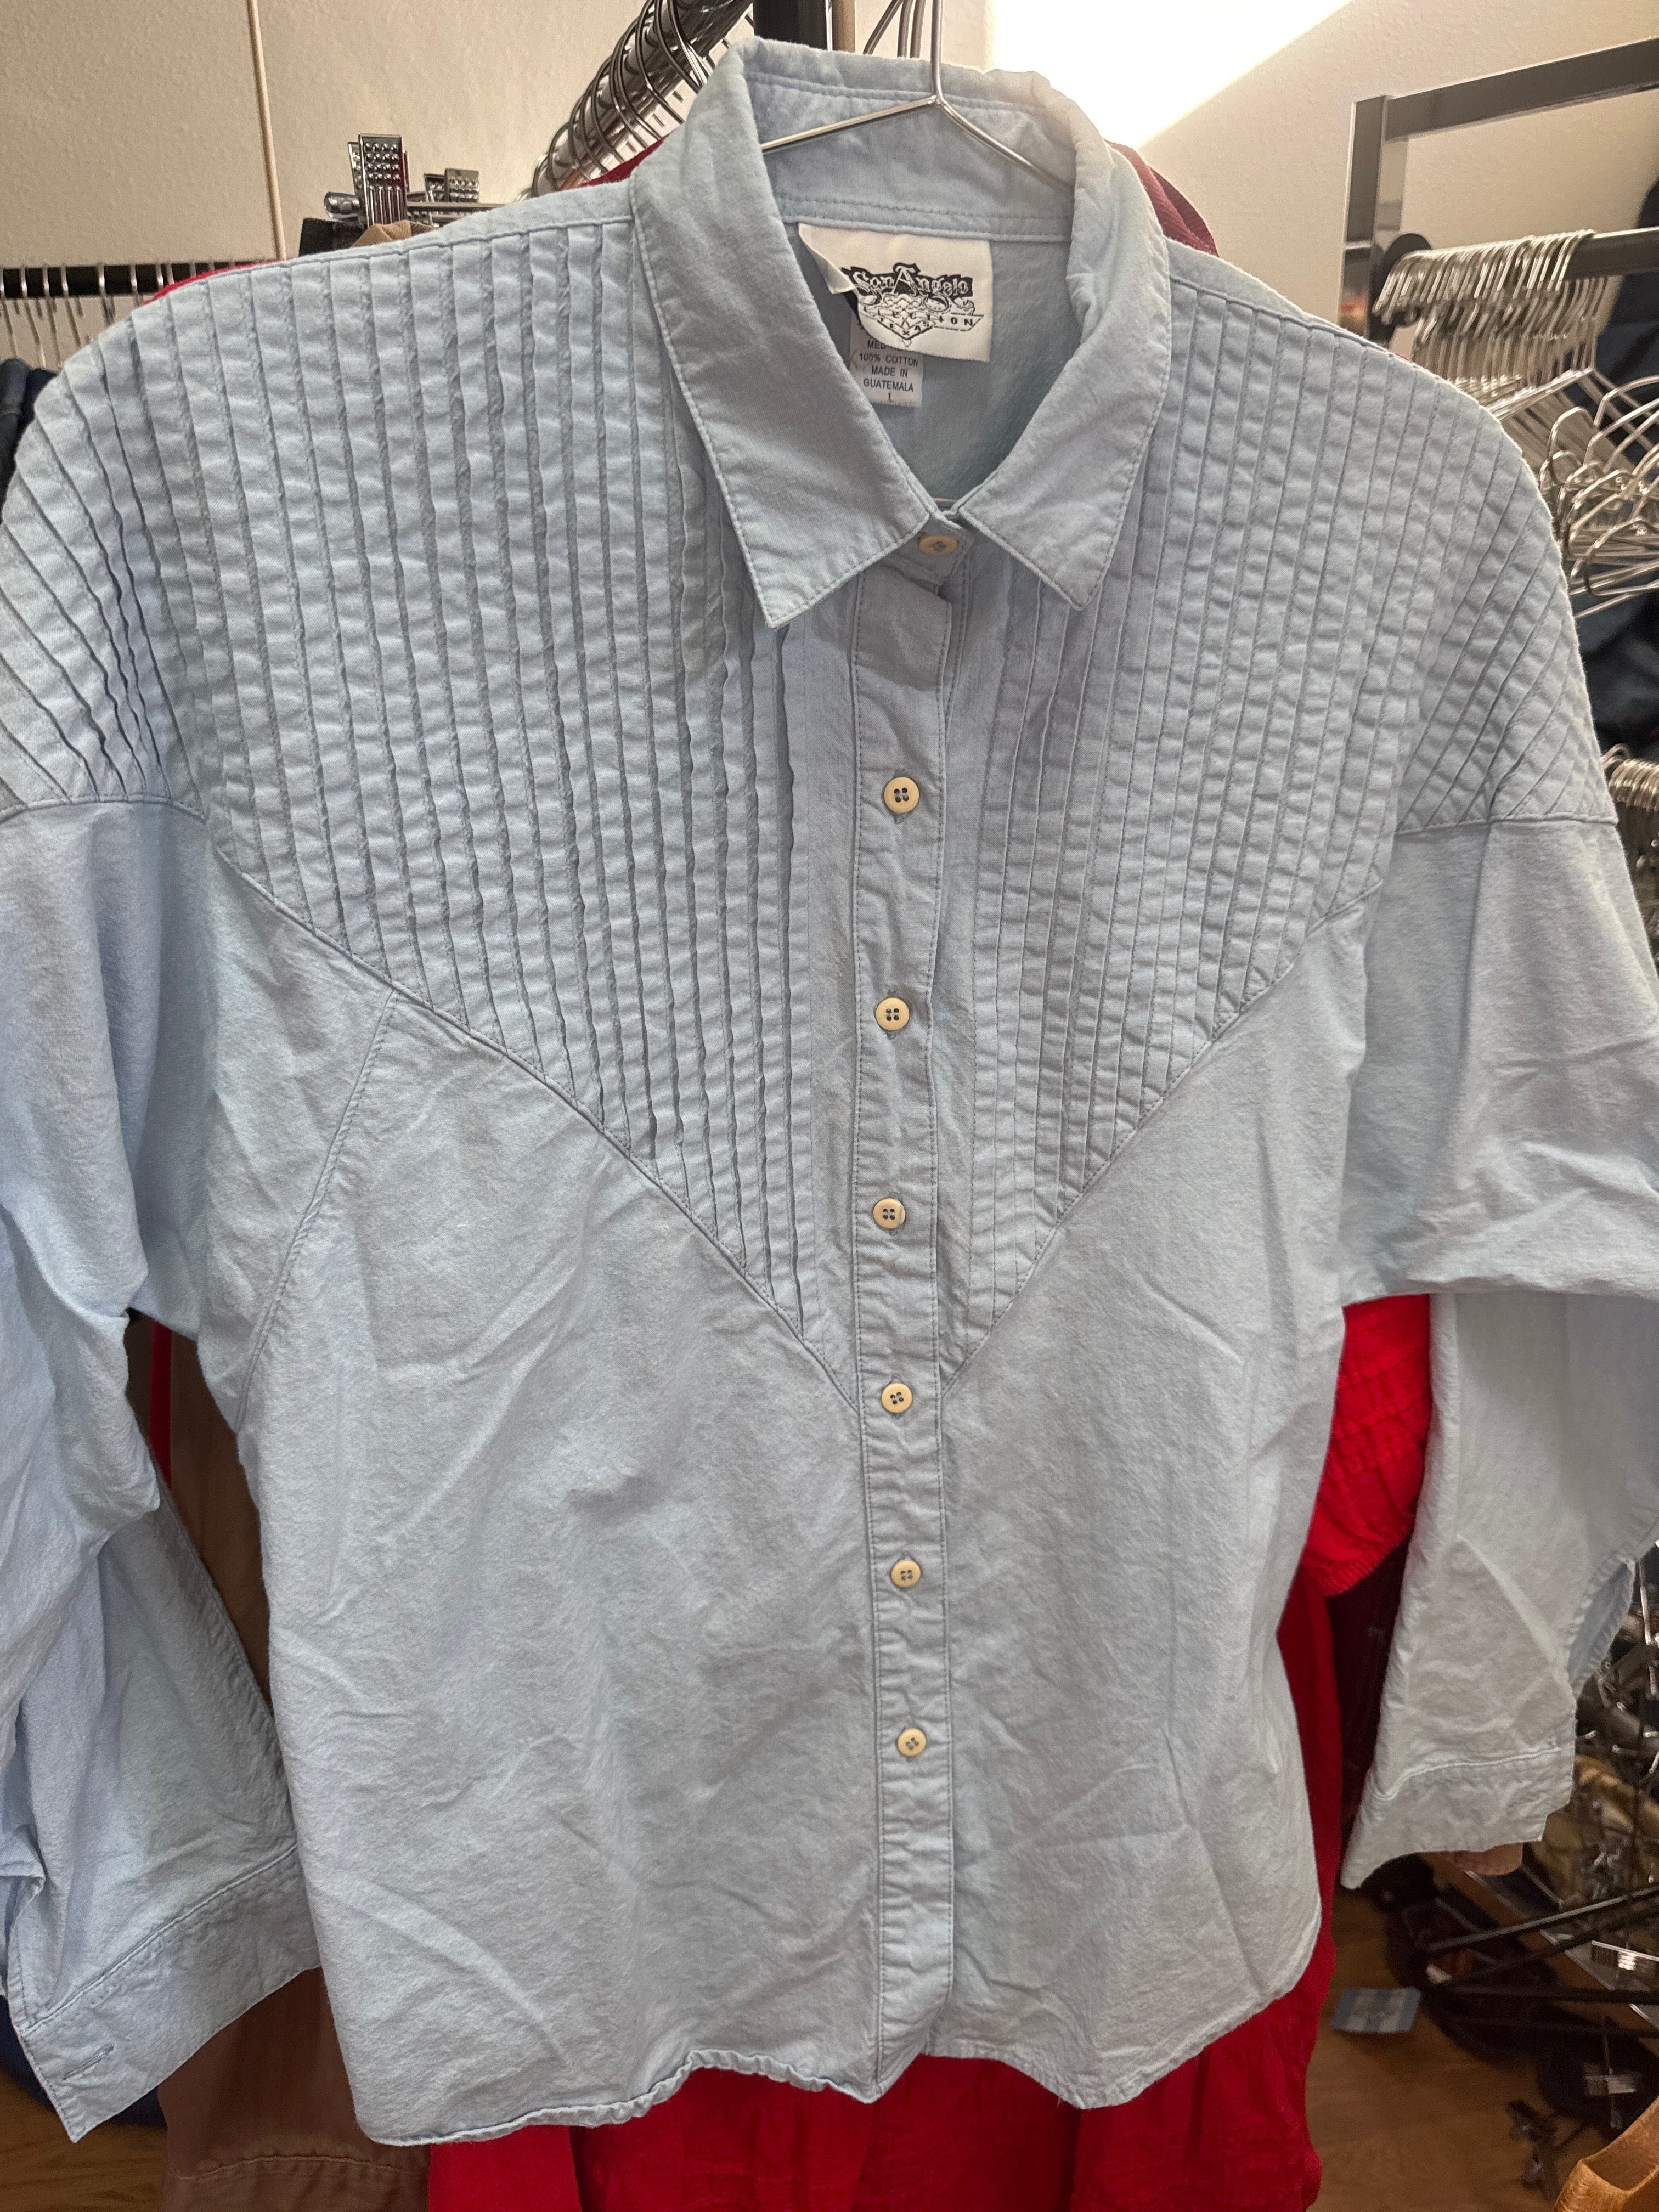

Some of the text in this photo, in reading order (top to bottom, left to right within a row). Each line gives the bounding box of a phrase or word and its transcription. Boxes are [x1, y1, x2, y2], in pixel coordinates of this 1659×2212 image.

[893, 265, 969, 296] Angelo
[859, 352, 919, 367] 100% COTTON
[871, 365, 909, 377] MADE IN
[863, 377, 914, 392] GUATEMALA
